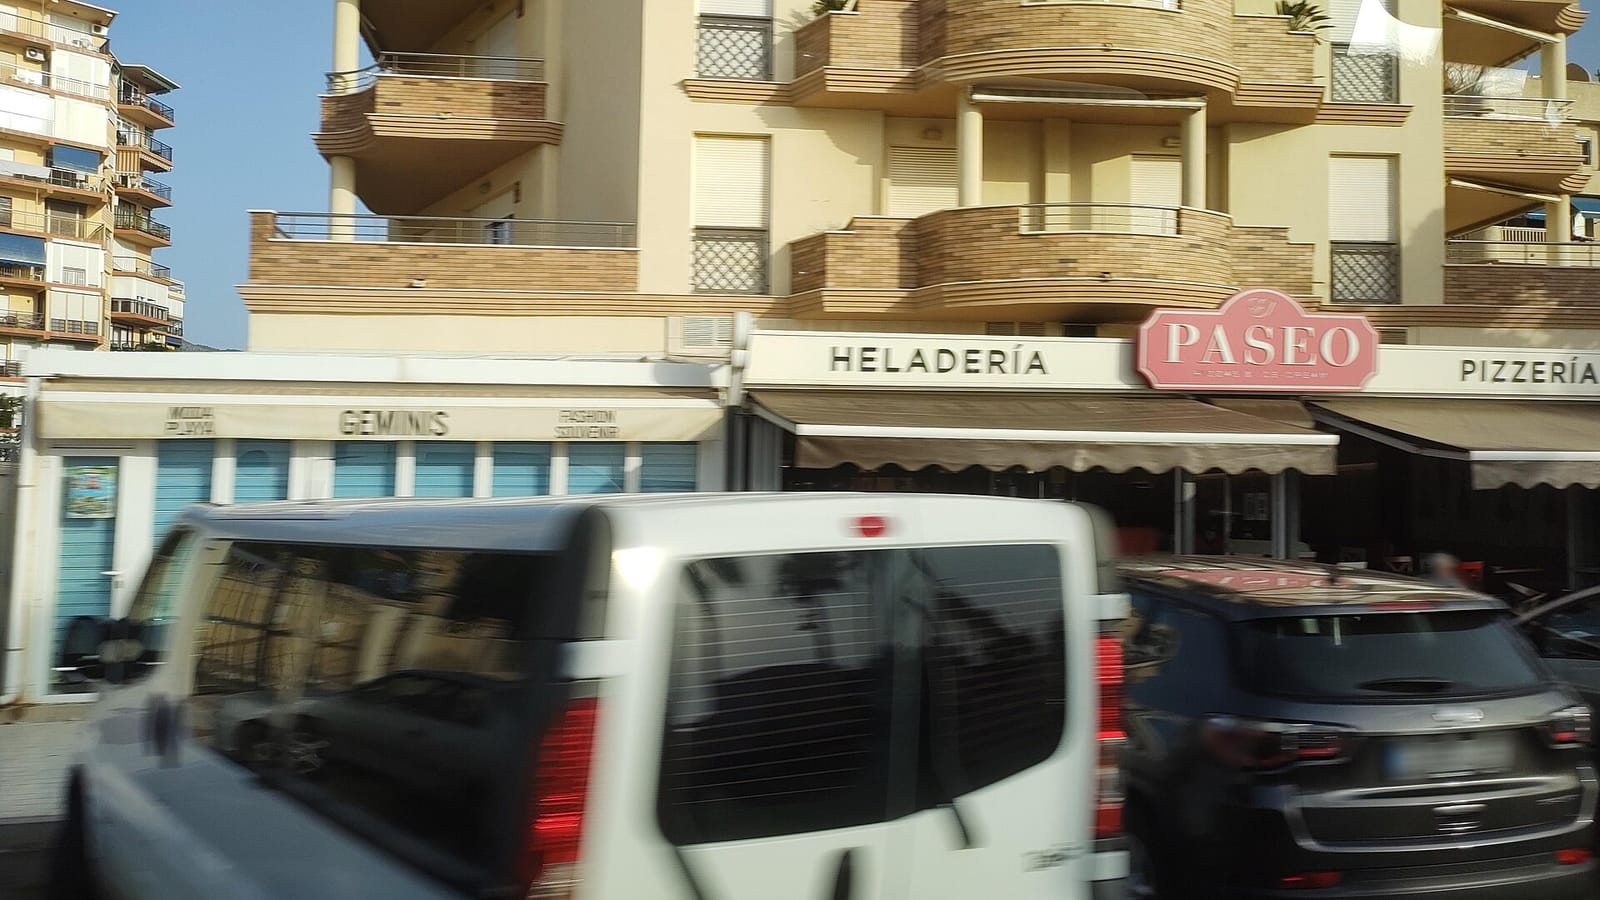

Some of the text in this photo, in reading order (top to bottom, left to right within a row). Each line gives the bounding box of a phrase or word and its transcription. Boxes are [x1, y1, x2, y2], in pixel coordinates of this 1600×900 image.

[1162, 323, 1361, 367] PASEO
[831, 344, 1049, 375] HELADERÍA
[1460, 356, 1599, 384] PIZZERÍA
[340, 409, 449, 436] GEMINIS
[559, 409, 617, 423] FASHION
